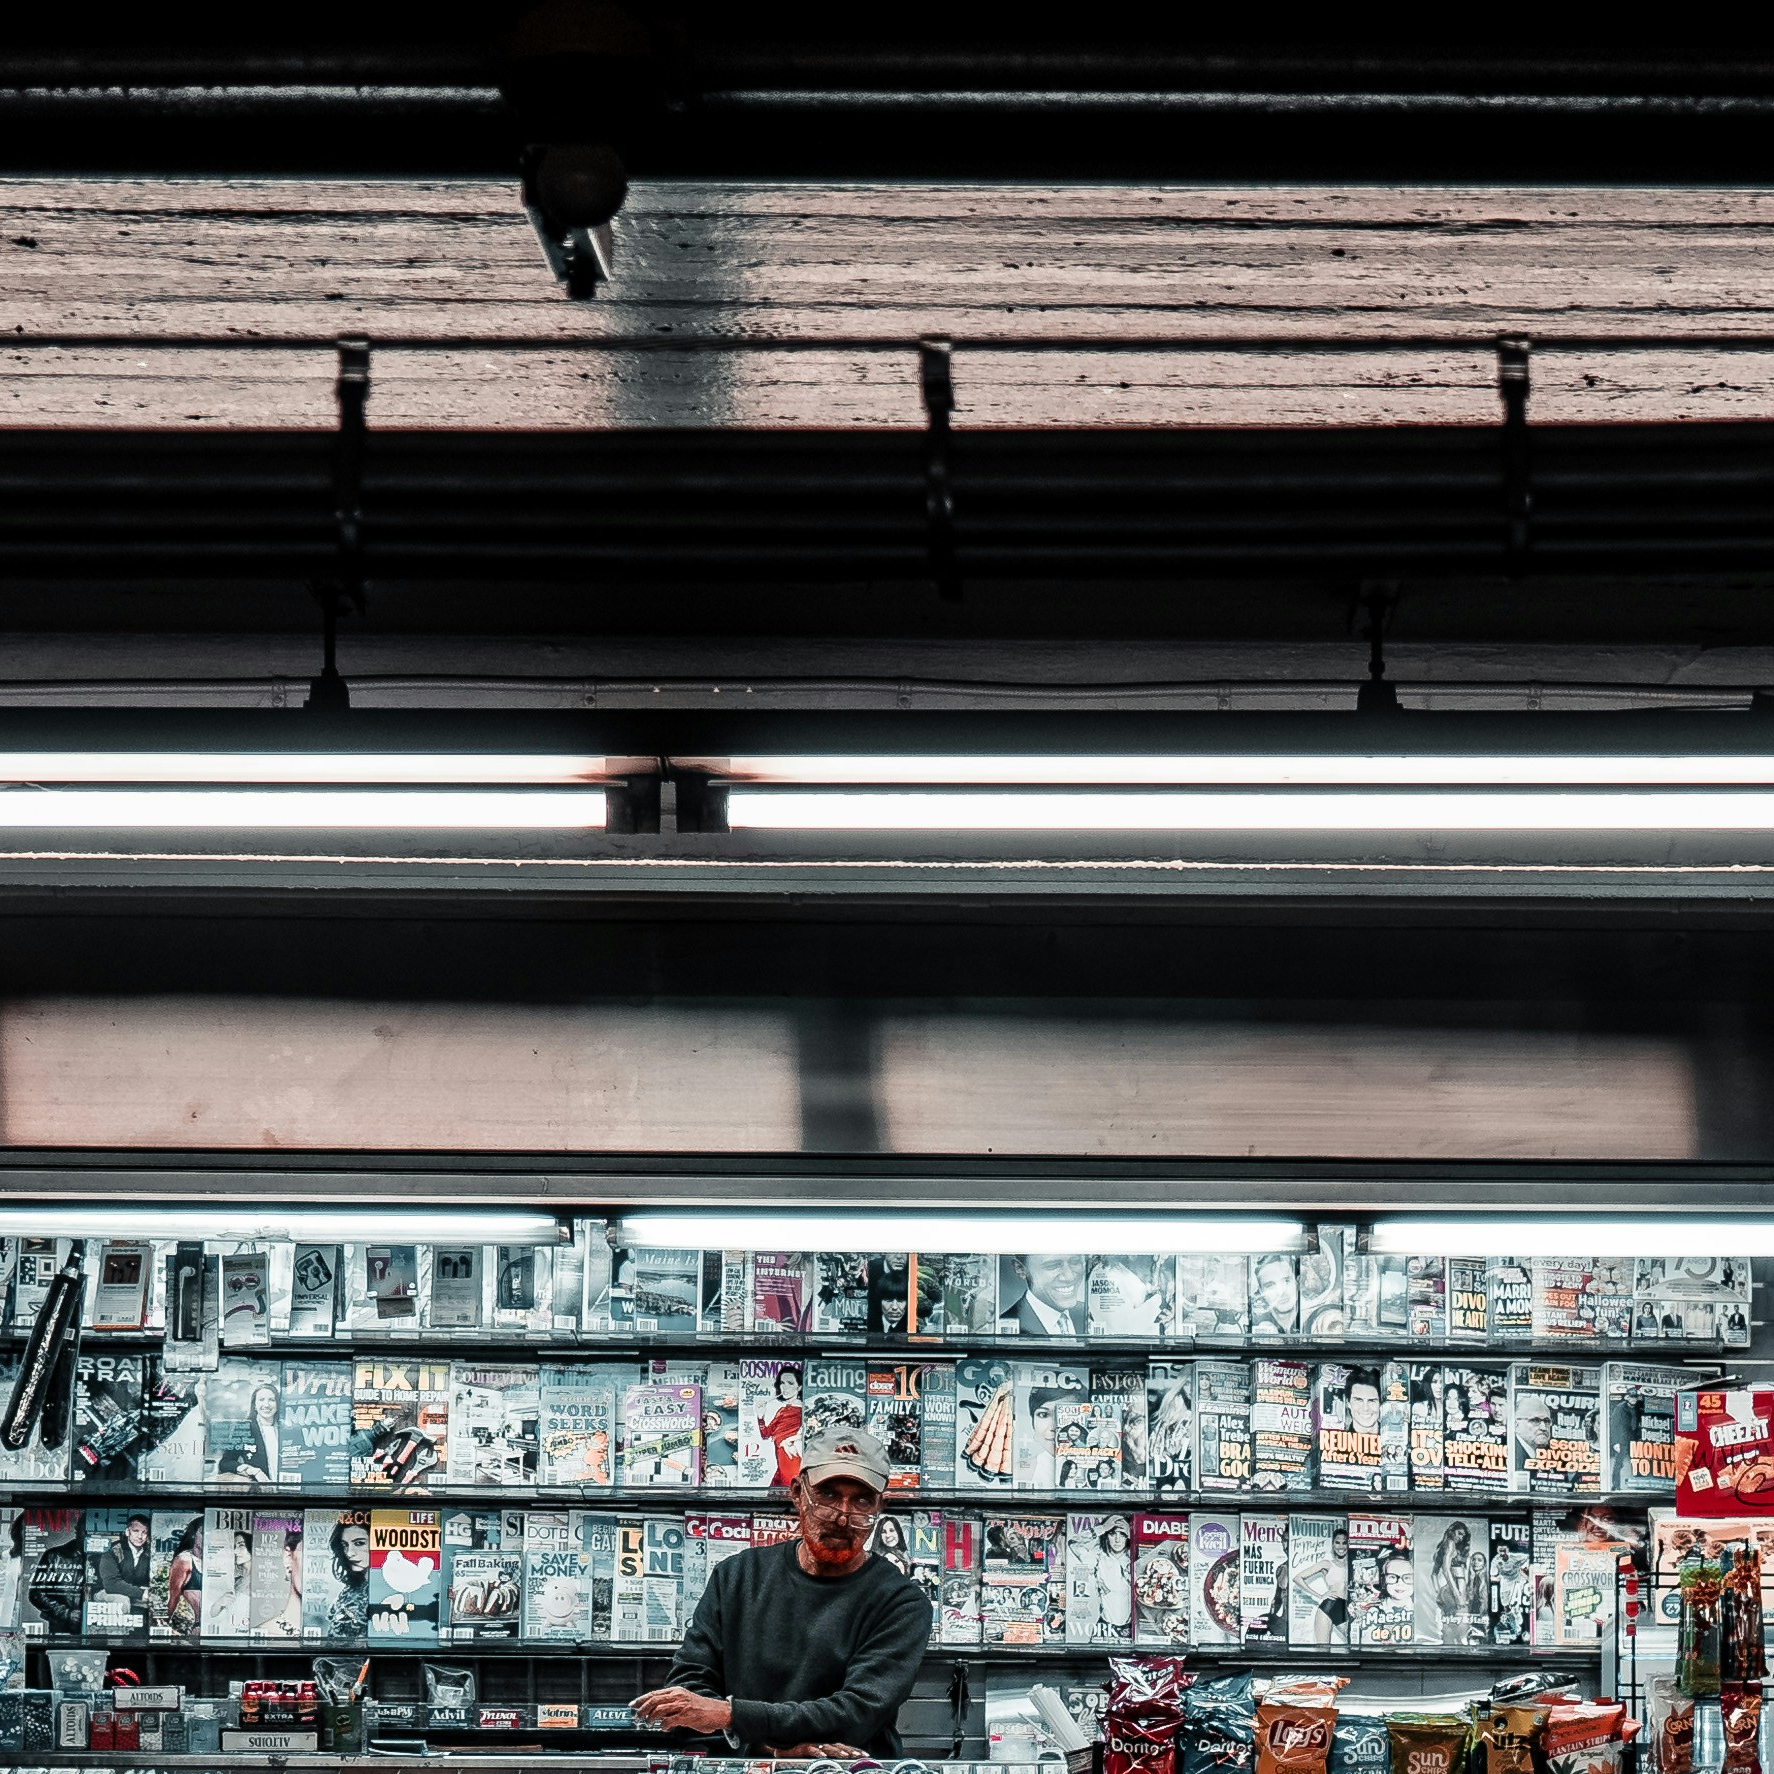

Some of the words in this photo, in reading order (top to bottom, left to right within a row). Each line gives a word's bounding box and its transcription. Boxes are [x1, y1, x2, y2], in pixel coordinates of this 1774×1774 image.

[355, 1364, 411, 1390] FIX
[417, 1364, 450, 1390] IT
[806, 1365, 866, 1392] Eating
[1018, 1365, 1081, 1390] Inc.
[380, 1389, 393, 1401] TO
[1700, 1394, 1722, 1408] 45
[284, 1405, 351, 1425] MAKE
[549, 1403, 607, 1418] WORD
[643, 1402, 686, 1415] EASY
[547, 1418, 609, 1431] SEEKS
[1219, 1415, 1245, 1428] Alex
[743, 1443, 760, 1458] 12
[1320, 1452, 1348, 1463] After
[1630, 1459, 1651, 1476] TO
[410, 1511, 435, 1524] LIFE
[455, 1558, 476, 1569] Fall
[478, 1558, 519, 1571] Baking
[540, 1552, 578, 1565] SAVE
[531, 1564, 589, 1578] MONEY
[88, 1613, 145, 1628] PRINCE
[130, 1691, 165, 1702] ALTOIDS
[430, 1707, 466, 1720] Advil
[593, 1710, 629, 1720] ALEVE
[248, 1737, 291, 1747] ALTOIDS
